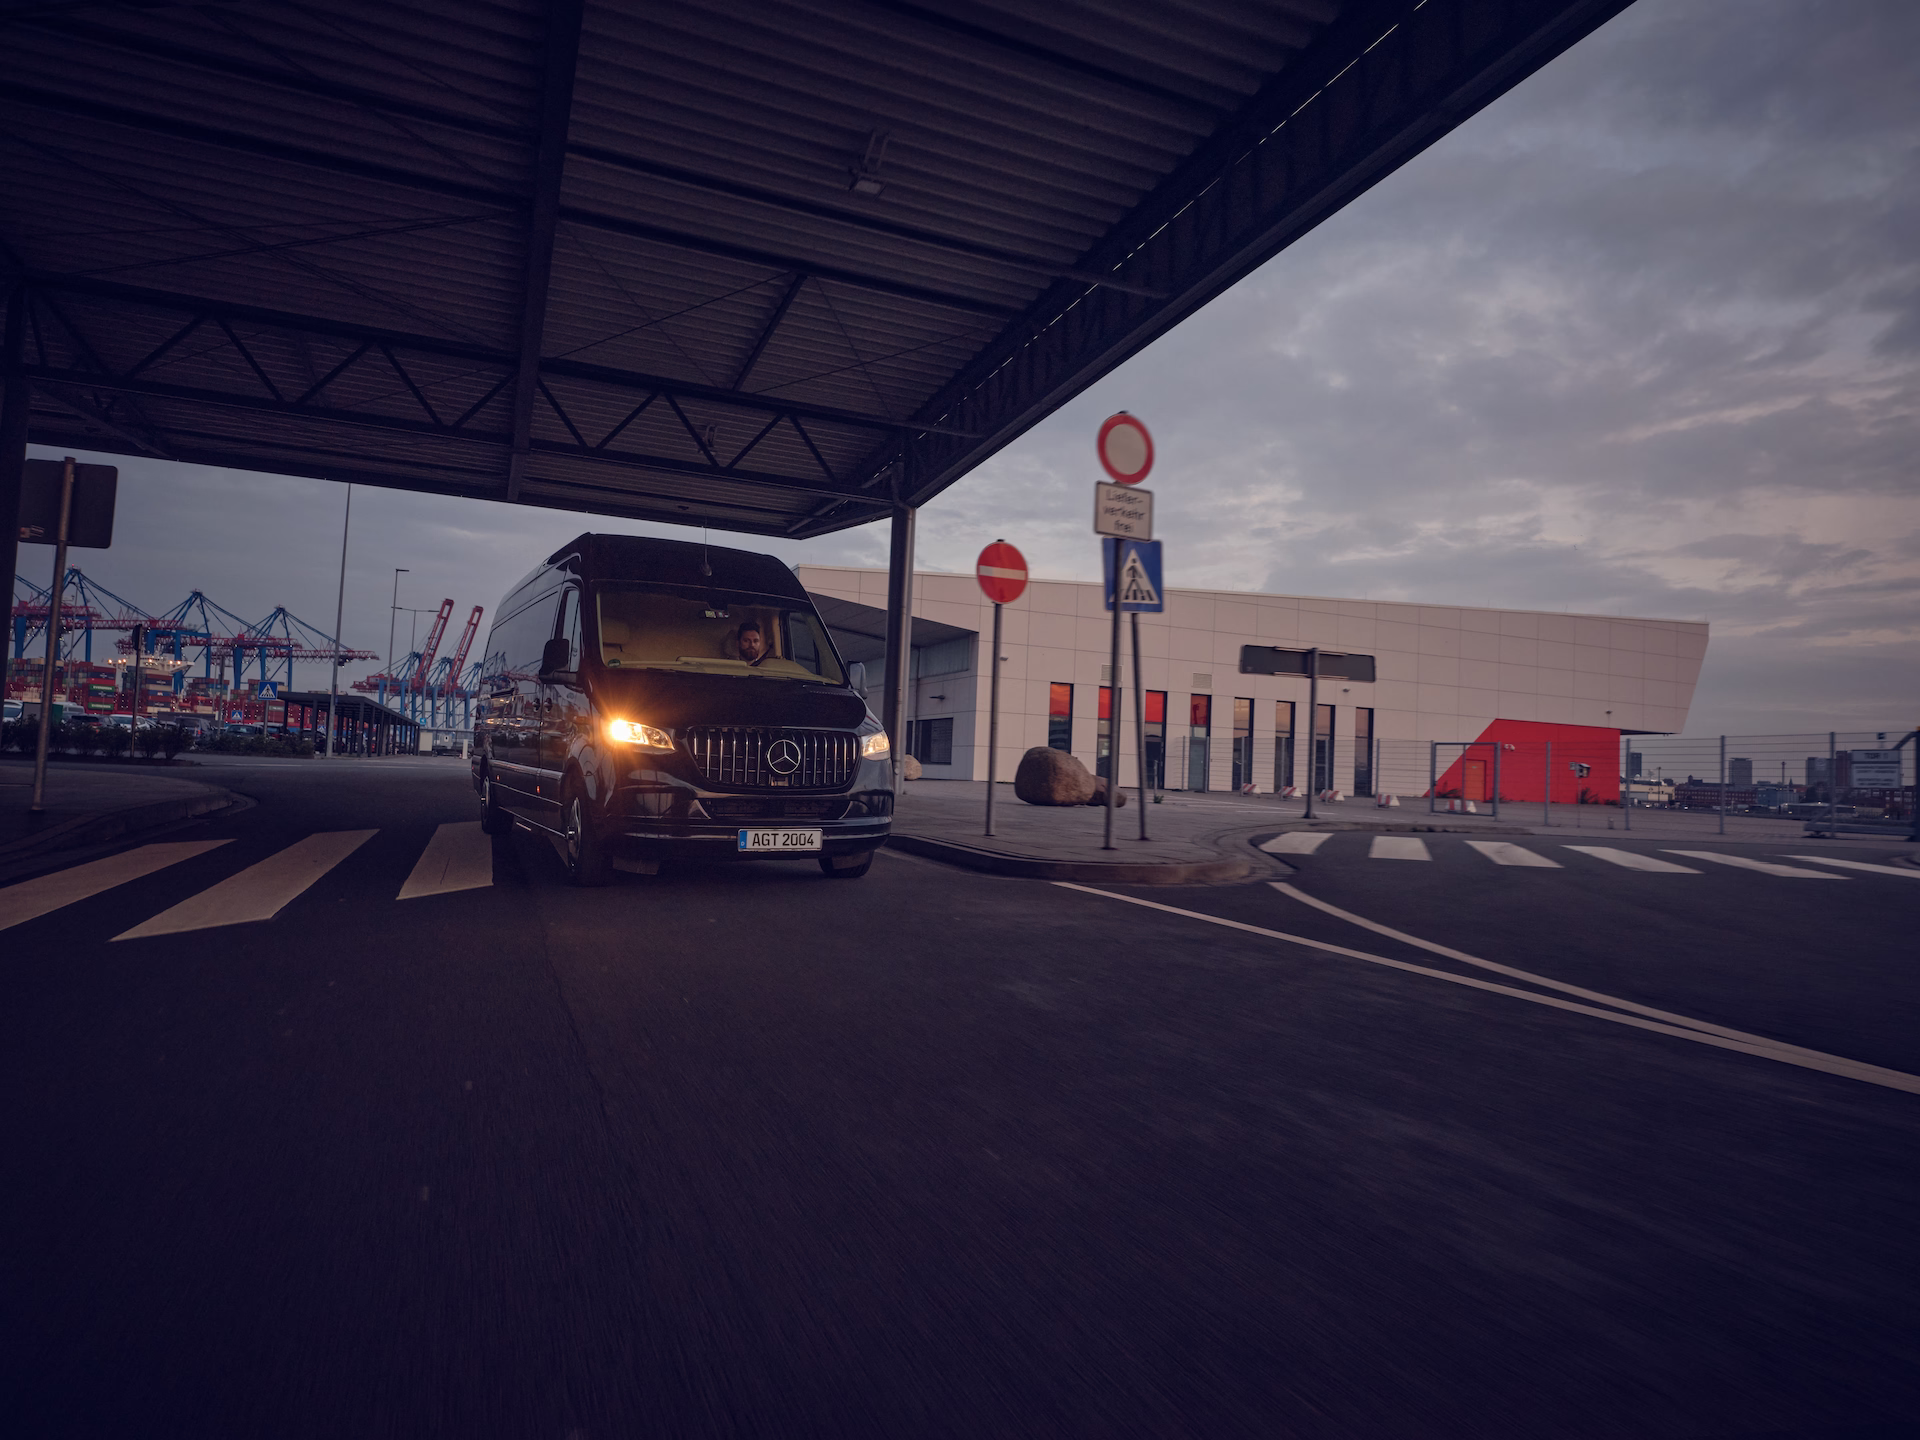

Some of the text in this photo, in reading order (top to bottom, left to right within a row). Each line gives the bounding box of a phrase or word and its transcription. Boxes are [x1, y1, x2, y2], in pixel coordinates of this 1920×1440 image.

[1106, 489, 1143, 504] Liefer-
[1103, 505, 1145, 520] verkehr
[1114, 519, 1134, 533] frei
[752, 833, 814, 846] AGT 2004
